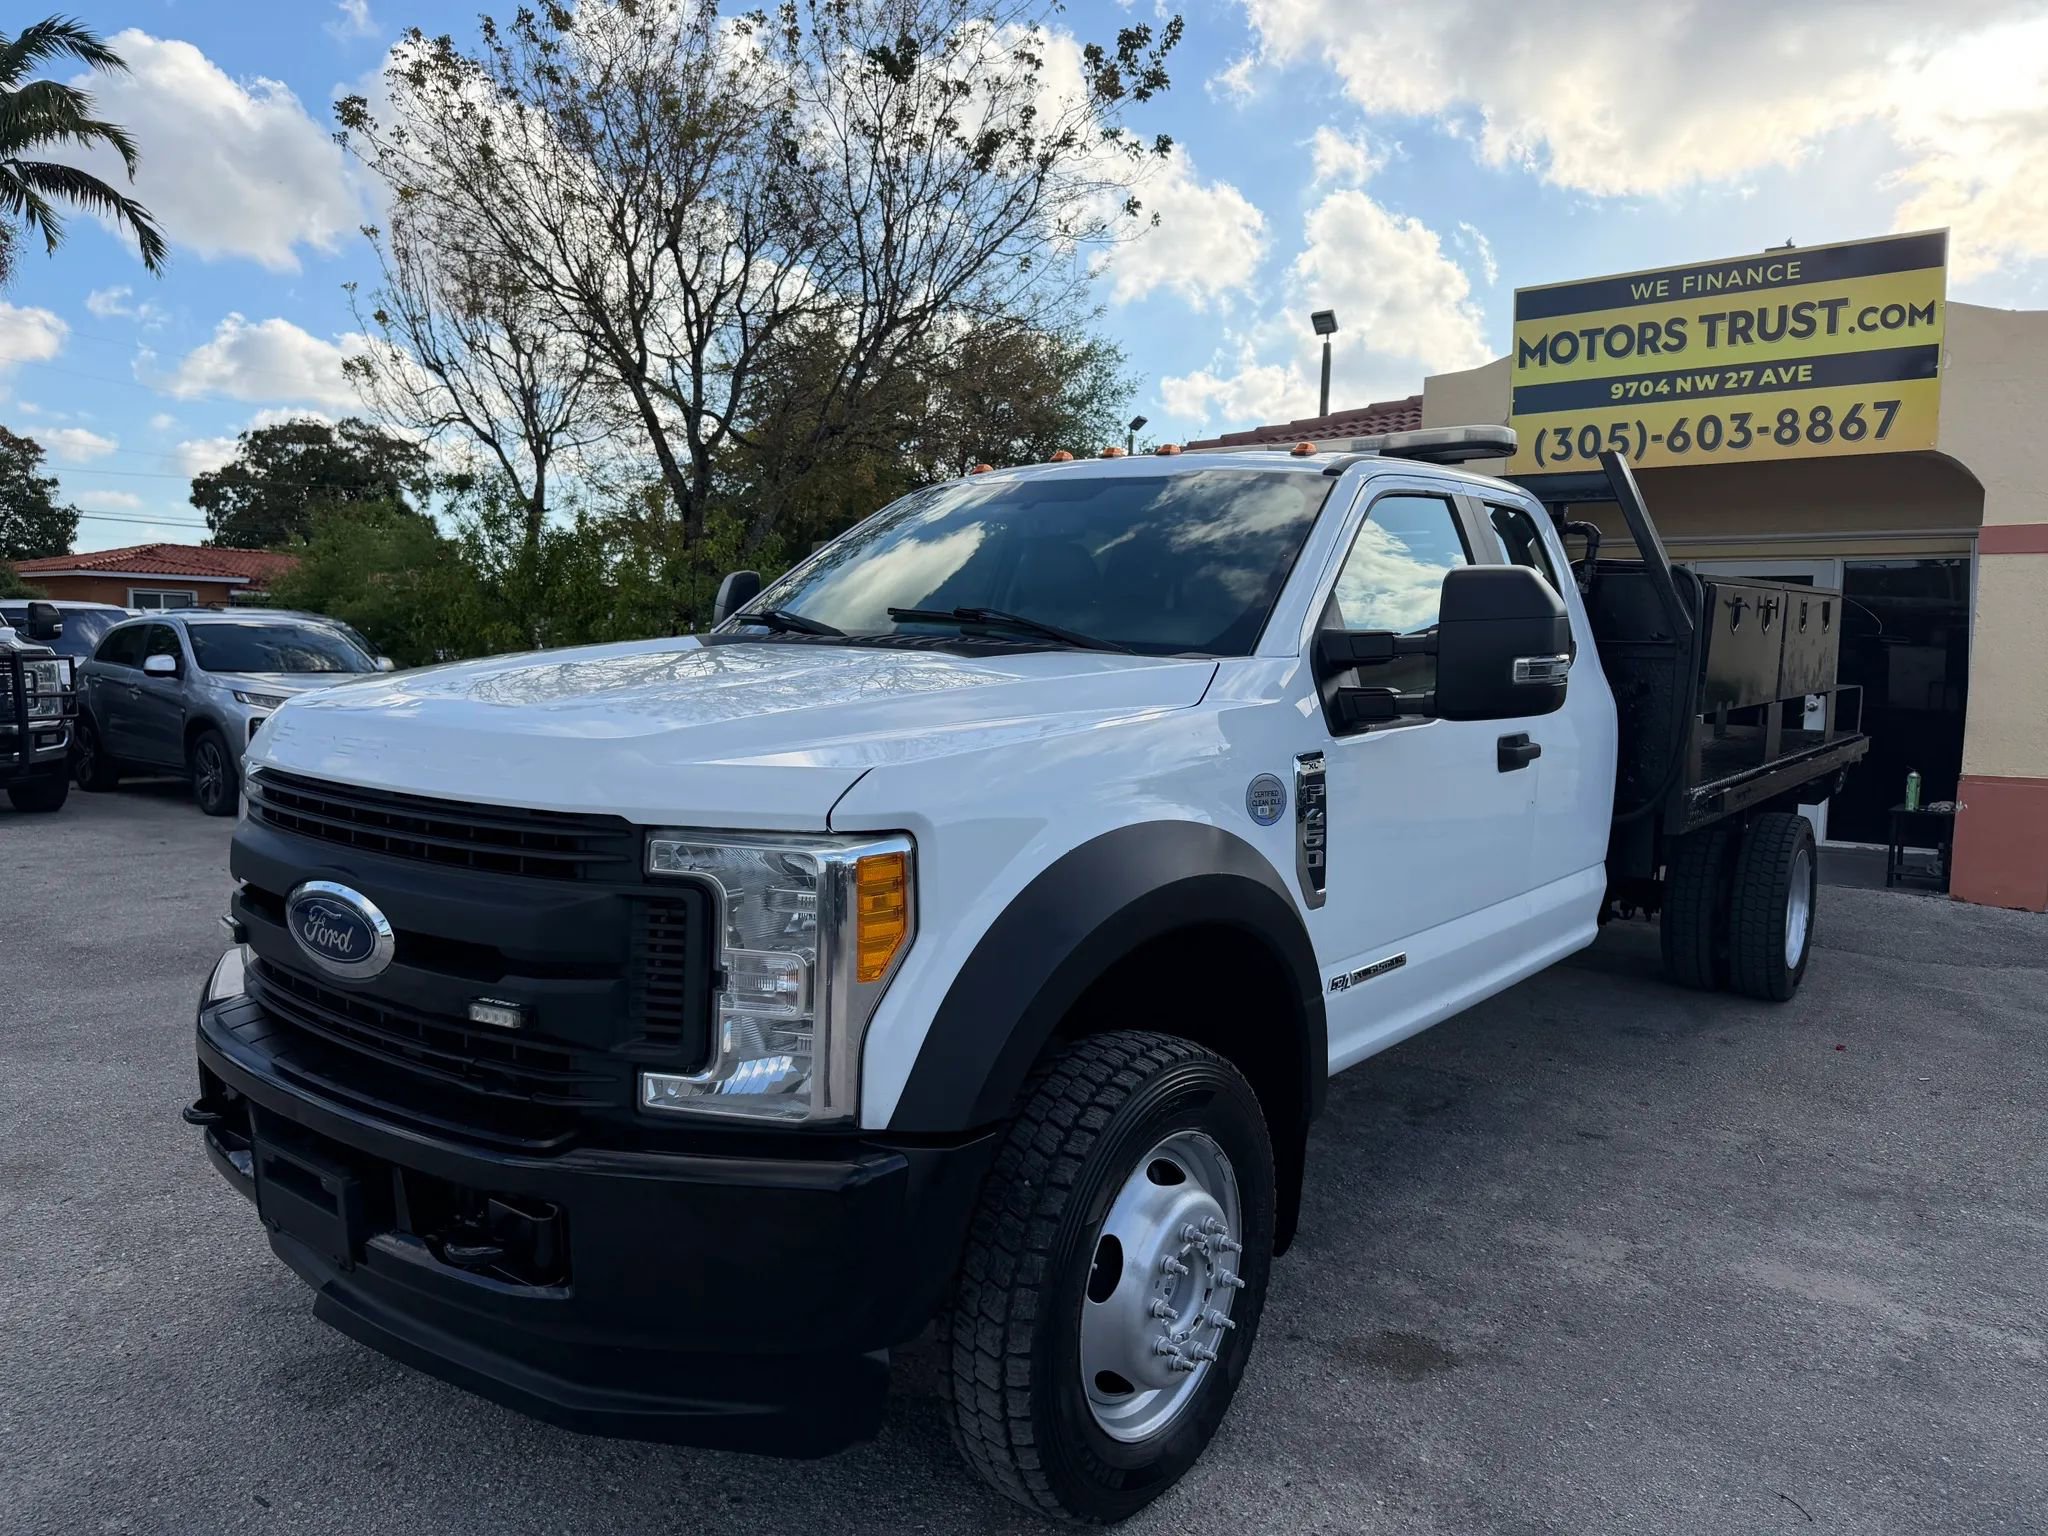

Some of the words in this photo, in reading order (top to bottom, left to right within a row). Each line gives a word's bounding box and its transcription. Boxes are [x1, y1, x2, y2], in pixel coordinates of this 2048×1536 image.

[1631, 279, 1669, 300] WE
[1682, 261, 1802, 294] FINANCE
[1518, 316, 1688, 369] MOTORS
[1698, 298, 1936, 348] TRUST.COM
[1611, 378, 1670, 399] 9704
[1676, 373, 1720, 394] NW
[1725, 370, 1755, 388] 27
[1758, 365, 1813, 385] AVE
[1534, 399, 1903, 469] (305)-603-8867
[1254, 790, 1279, 798] CERTIFIED
[304, 905, 353, 953] Ford
